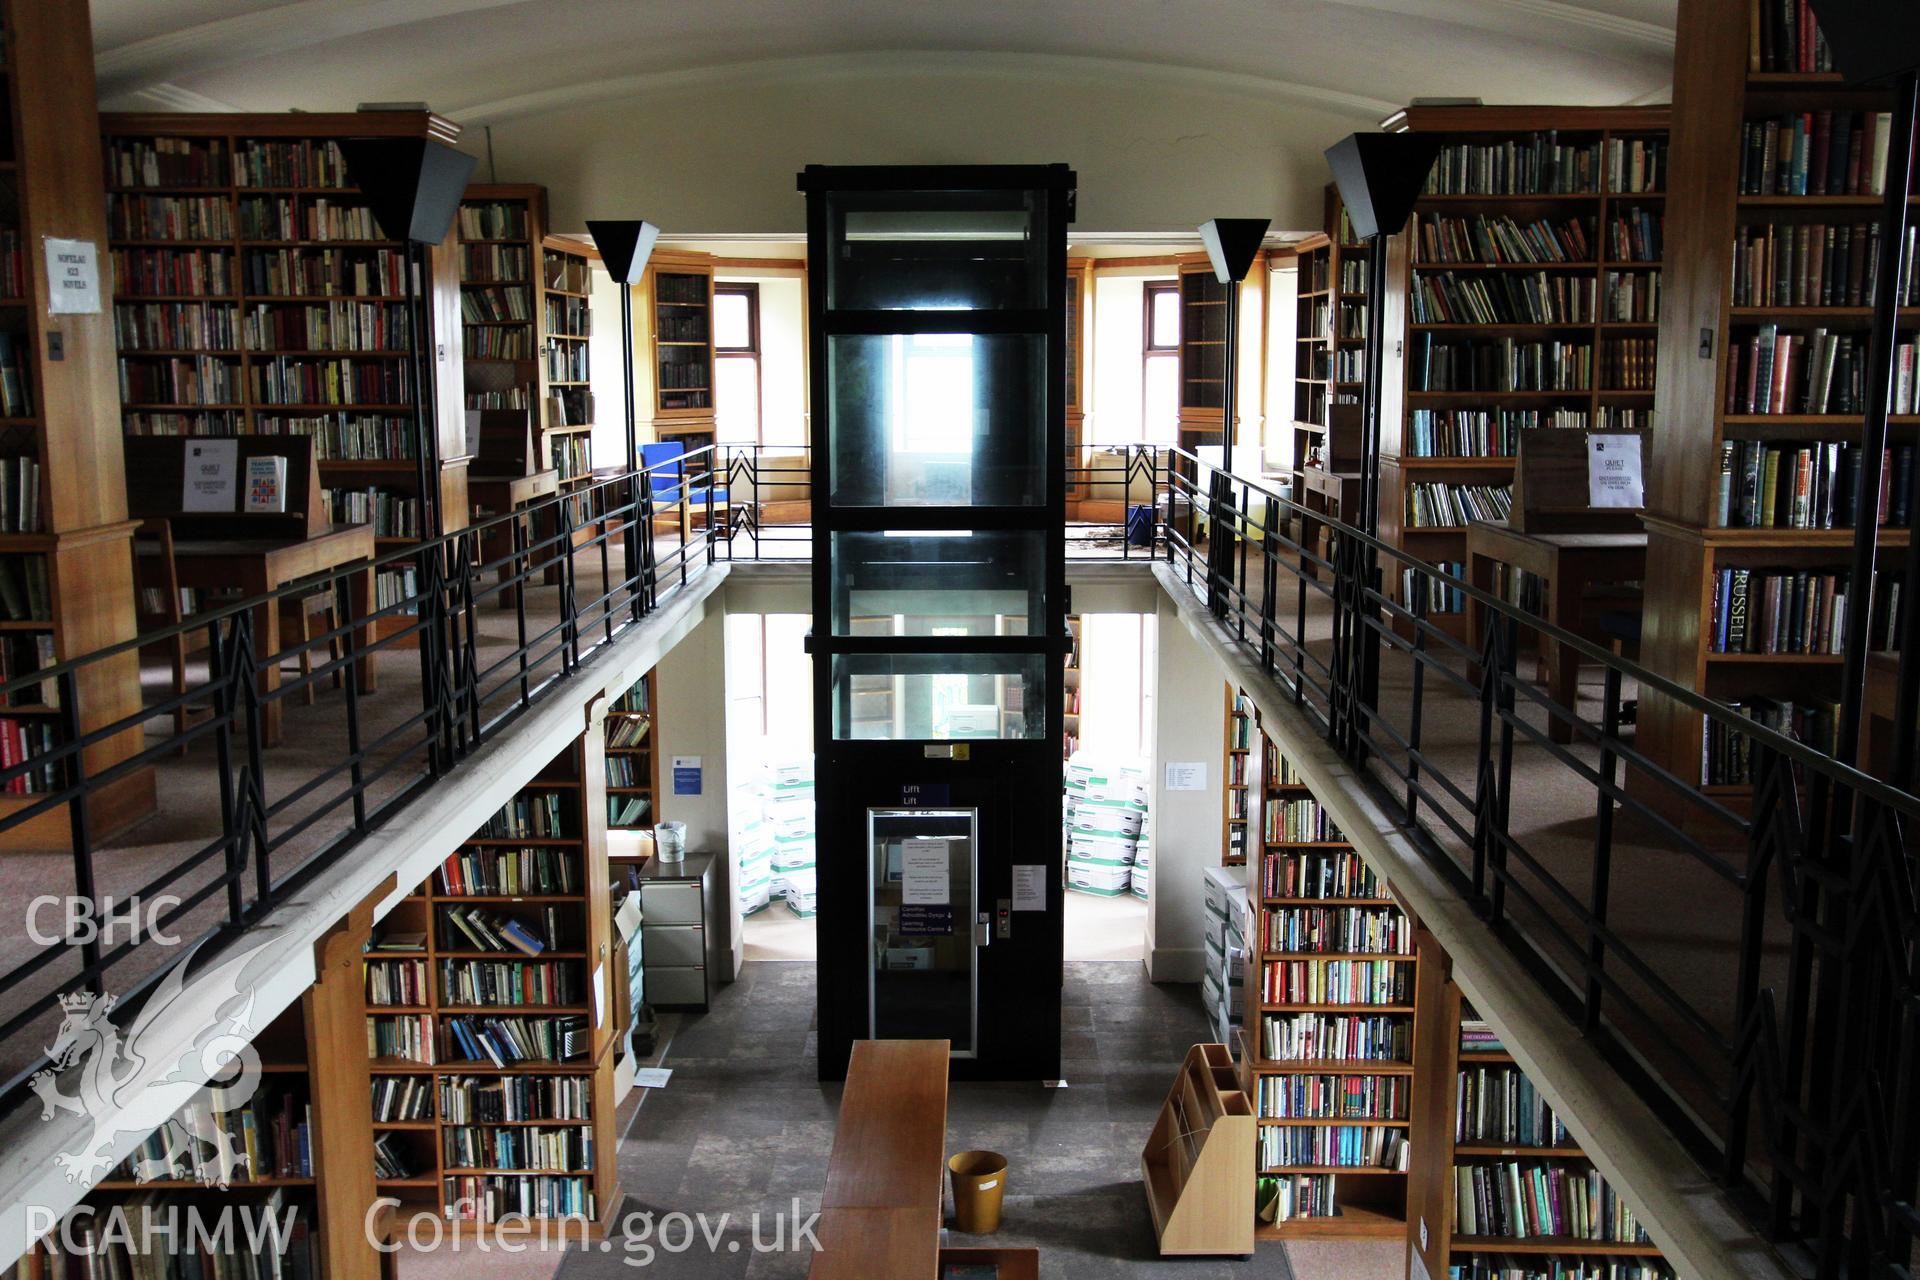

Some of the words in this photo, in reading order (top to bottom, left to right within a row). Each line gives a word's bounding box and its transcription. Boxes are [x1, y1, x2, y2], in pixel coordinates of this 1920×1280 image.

[1729, 575, 1747, 642] RUSSELL
[903, 785, 920, 793] Lifft
[903, 797, 917, 805] Lift
